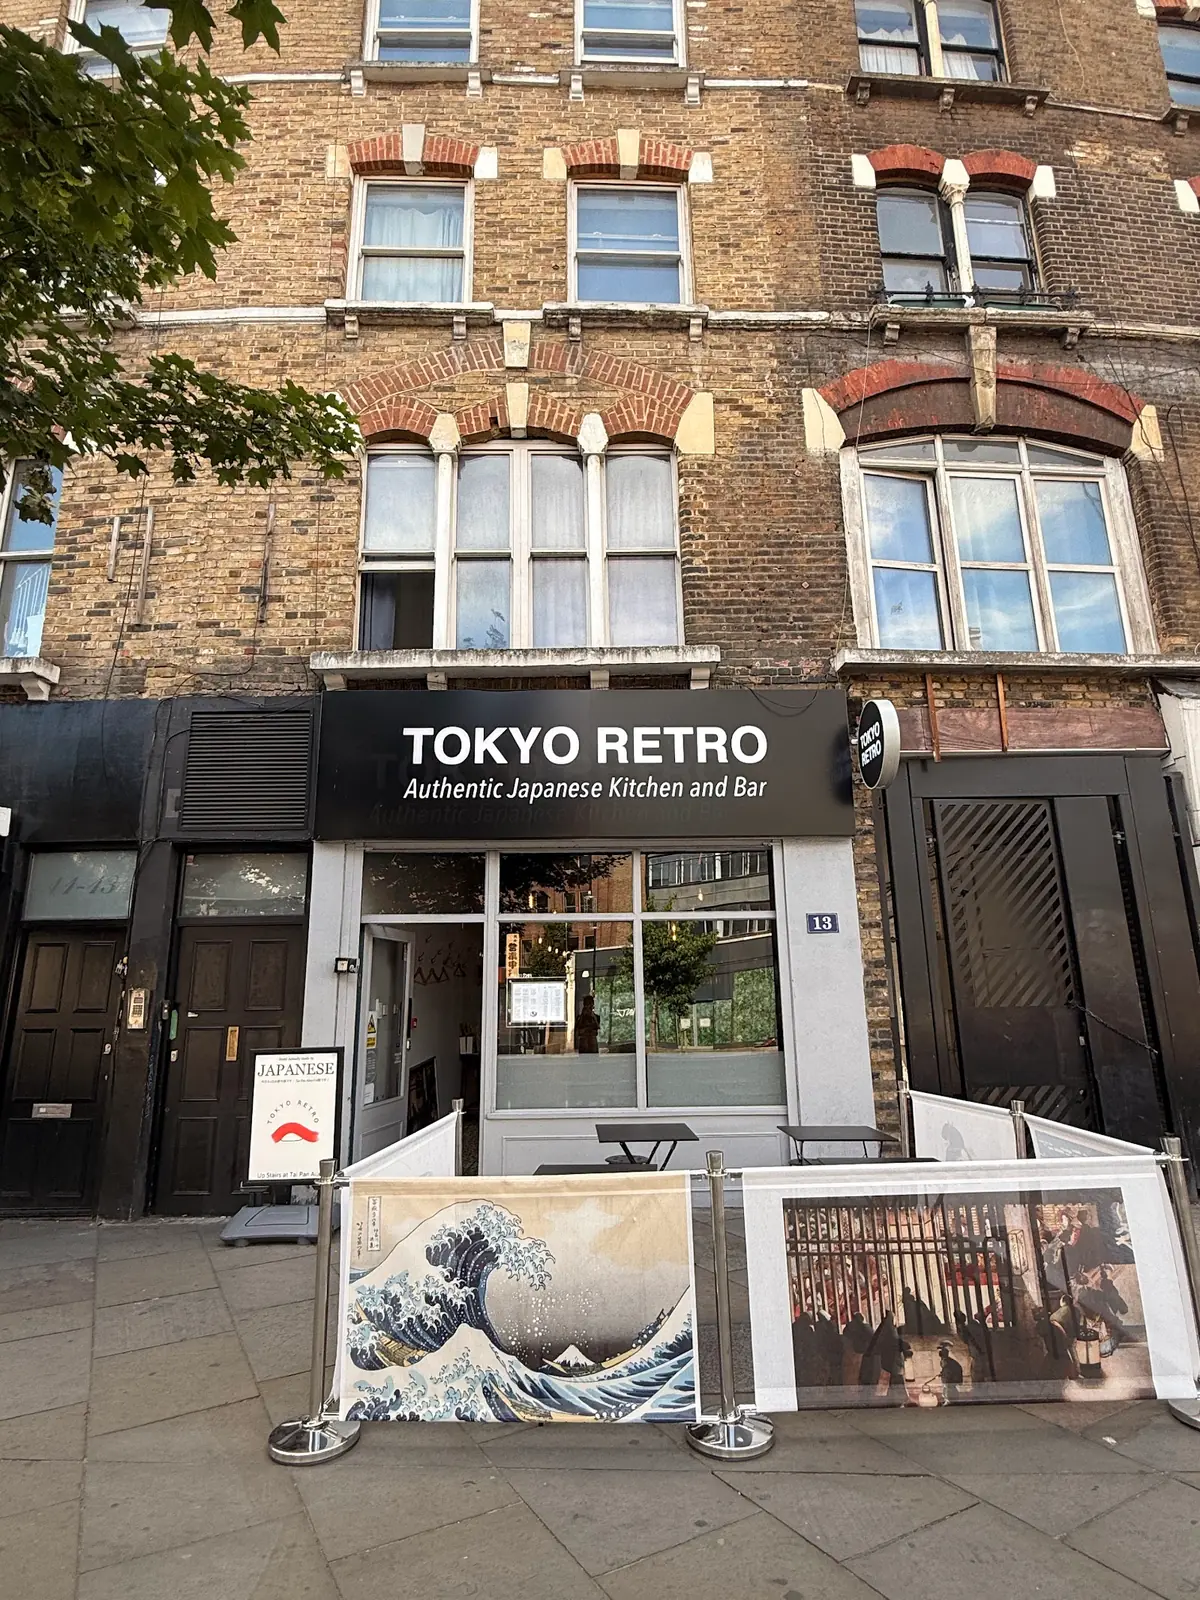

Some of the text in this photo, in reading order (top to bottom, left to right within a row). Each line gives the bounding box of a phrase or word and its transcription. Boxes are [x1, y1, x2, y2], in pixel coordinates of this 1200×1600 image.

[403, 725, 768, 765] TOKYO RETRO
[859, 721, 880, 750] TOKYO
[861, 739, 882, 767] RETRO
[403, 775, 768, 804] Authentic Japanese Kitchen and Bar
[812, 916, 832, 930] 13
[257, 1062, 335, 1077] JAPANESE
[266, 1099, 320, 1125] TOKYO RETRO
